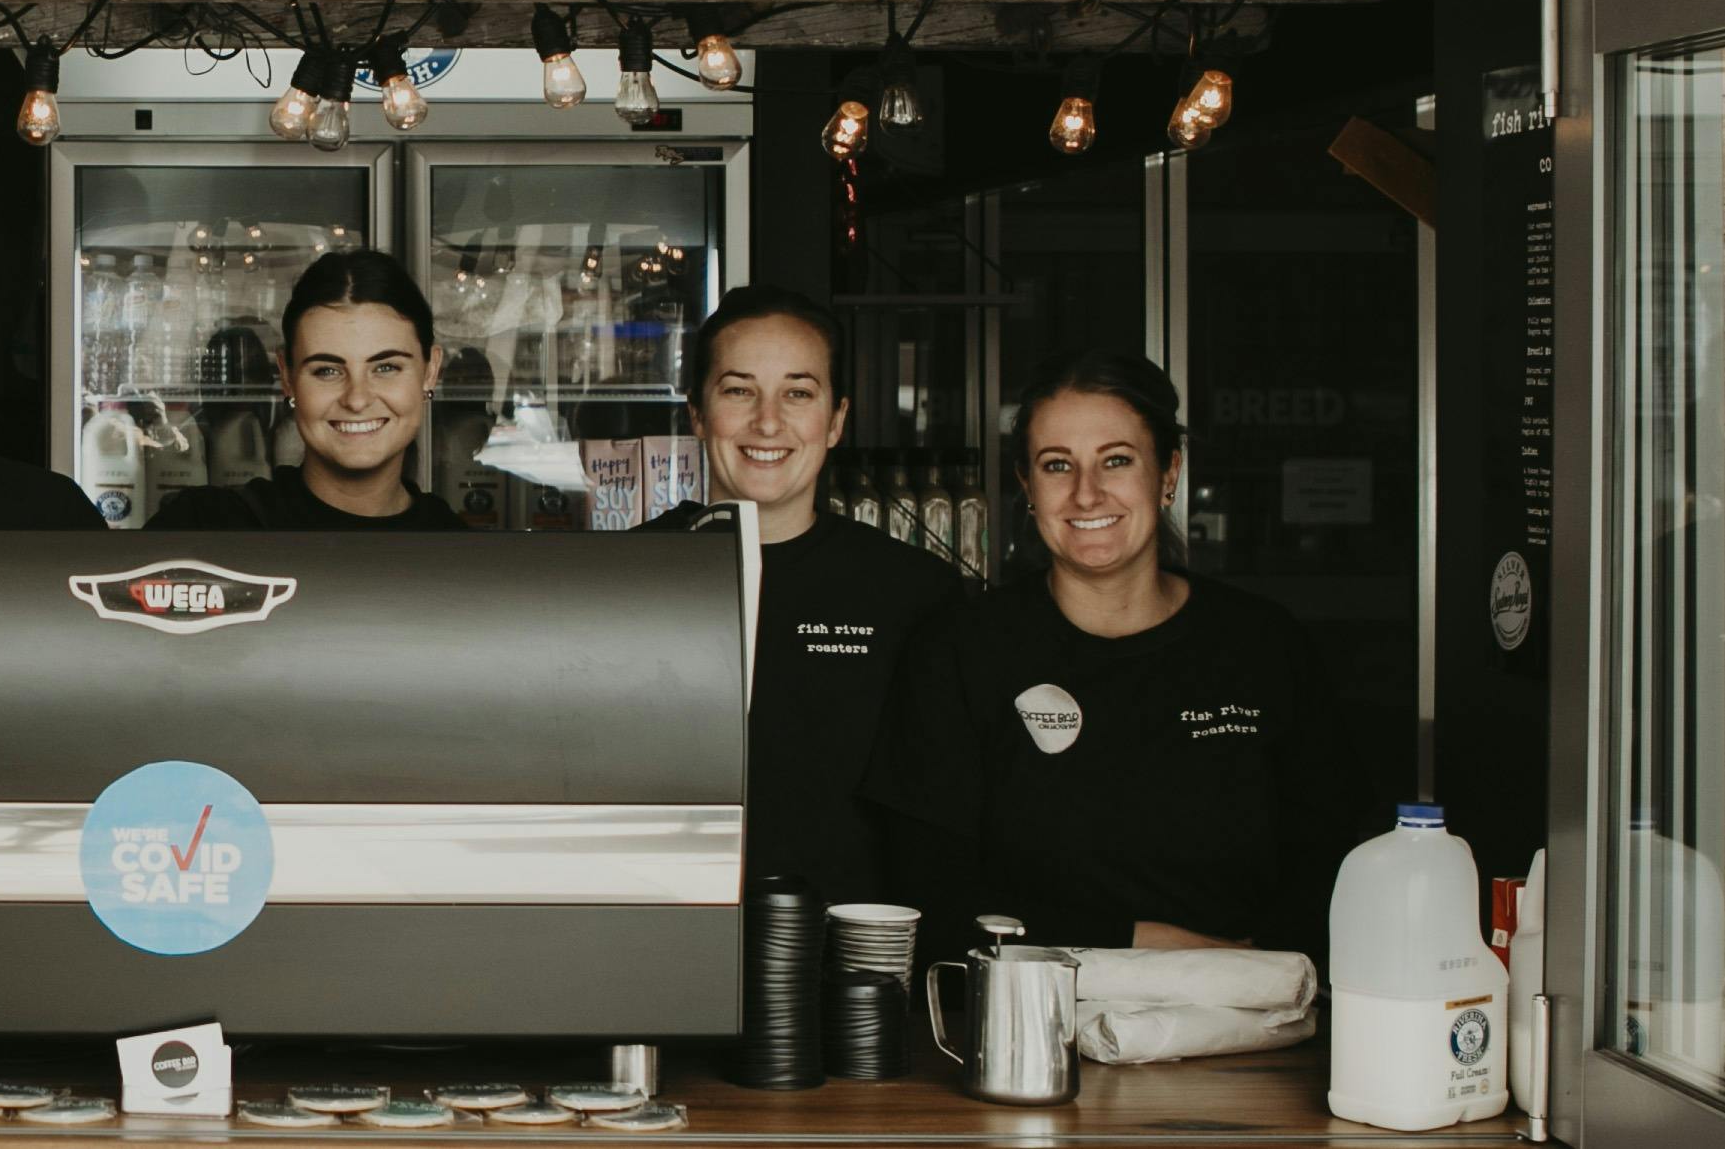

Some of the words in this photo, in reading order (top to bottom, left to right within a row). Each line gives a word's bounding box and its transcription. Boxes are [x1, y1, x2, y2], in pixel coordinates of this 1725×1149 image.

[1491, 109, 1522, 138] fish
[1212, 389, 1346, 426] BREED
[592, 457, 630, 474] Happy
[599, 473, 636, 490] happy
[595, 486, 637, 510] SOY
[144, 584, 225, 609] WEGA
[796, 623, 829, 634] fish
[834, 624, 874, 635] river
[806, 643, 868, 653] roasters
[1180, 710, 1213, 721] fish
[1220, 704, 1260, 717] river
[1191, 723, 1258, 738] roasters
[112, 827, 169, 843] WE'RE
[121, 872, 230, 904] SAFE
